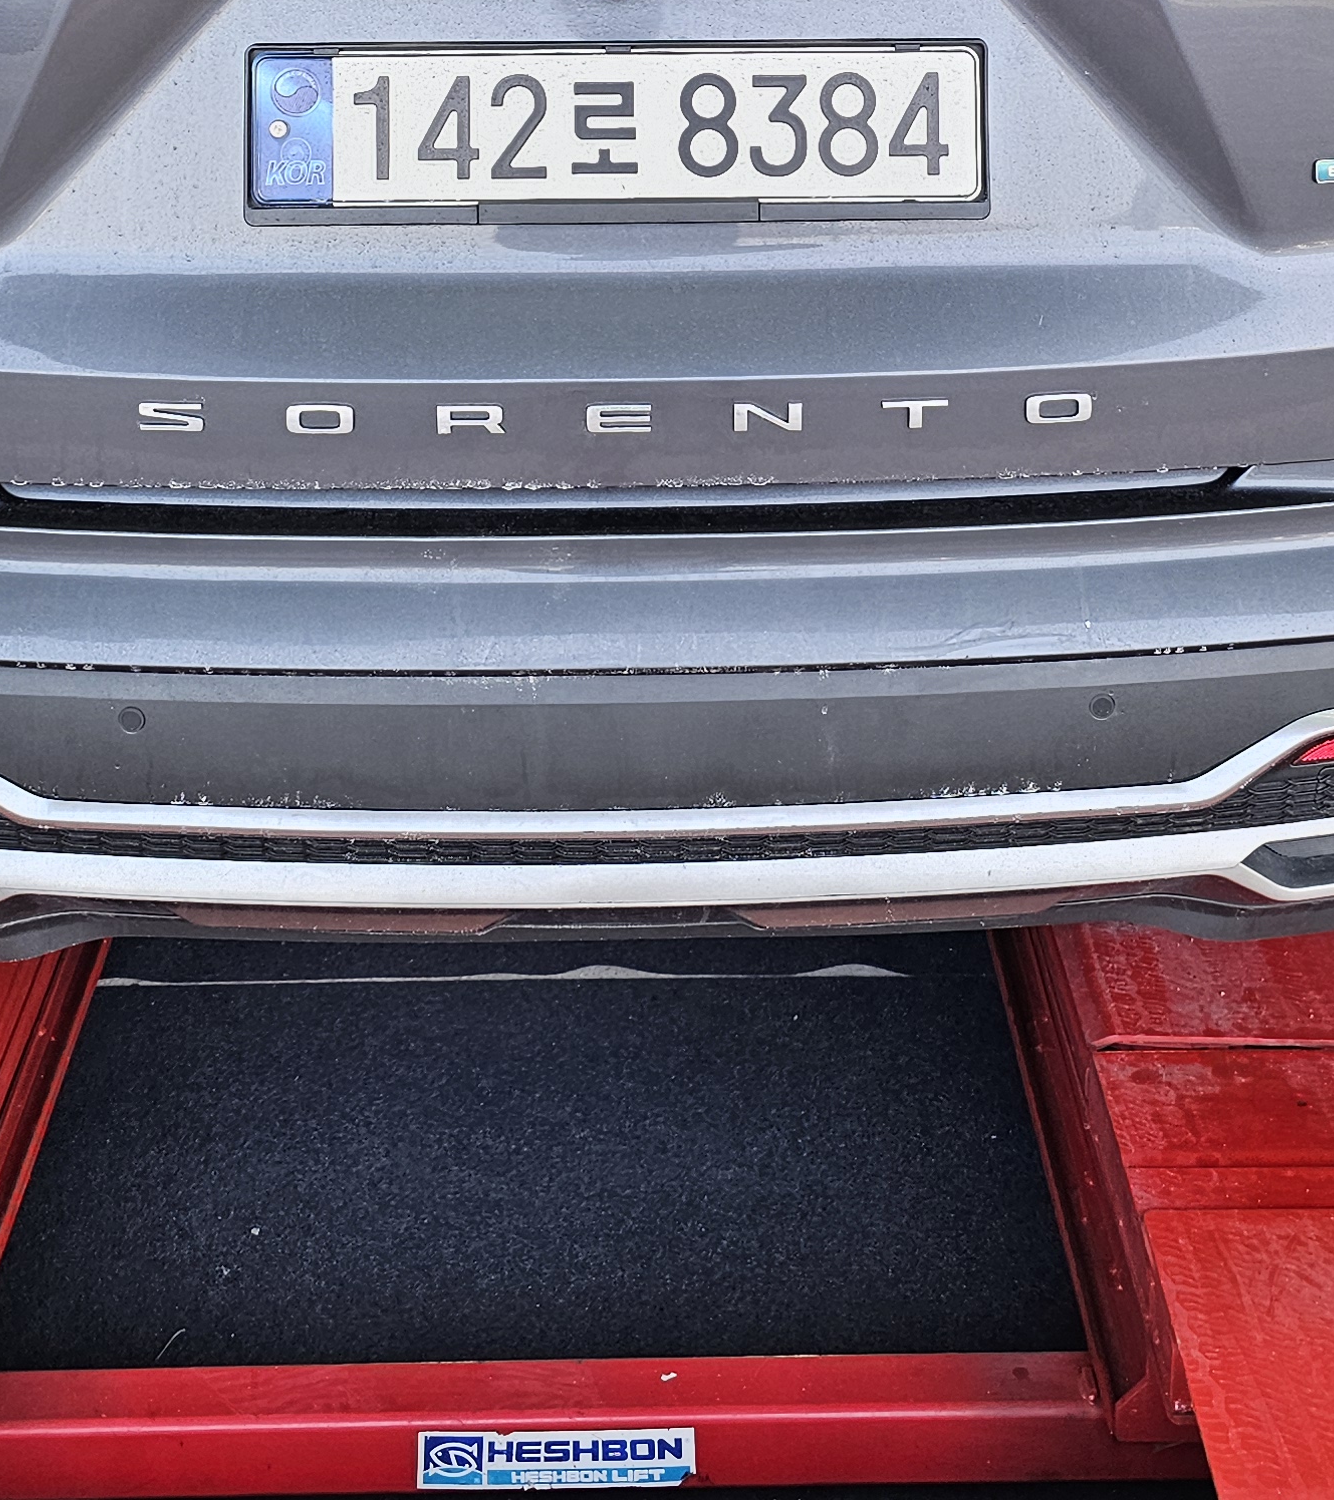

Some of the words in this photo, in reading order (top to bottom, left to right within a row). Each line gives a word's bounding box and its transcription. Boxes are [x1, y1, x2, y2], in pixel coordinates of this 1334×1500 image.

[677, 71, 951, 178] 8384
[265, 159, 327, 187] KOR
[136, 391, 1093, 436] SORENTO
[487, 1437, 684, 1464] HESHBON
[510, 1469, 609, 1485] HESHBON
[611, 1467, 667, 1483] LIFT
